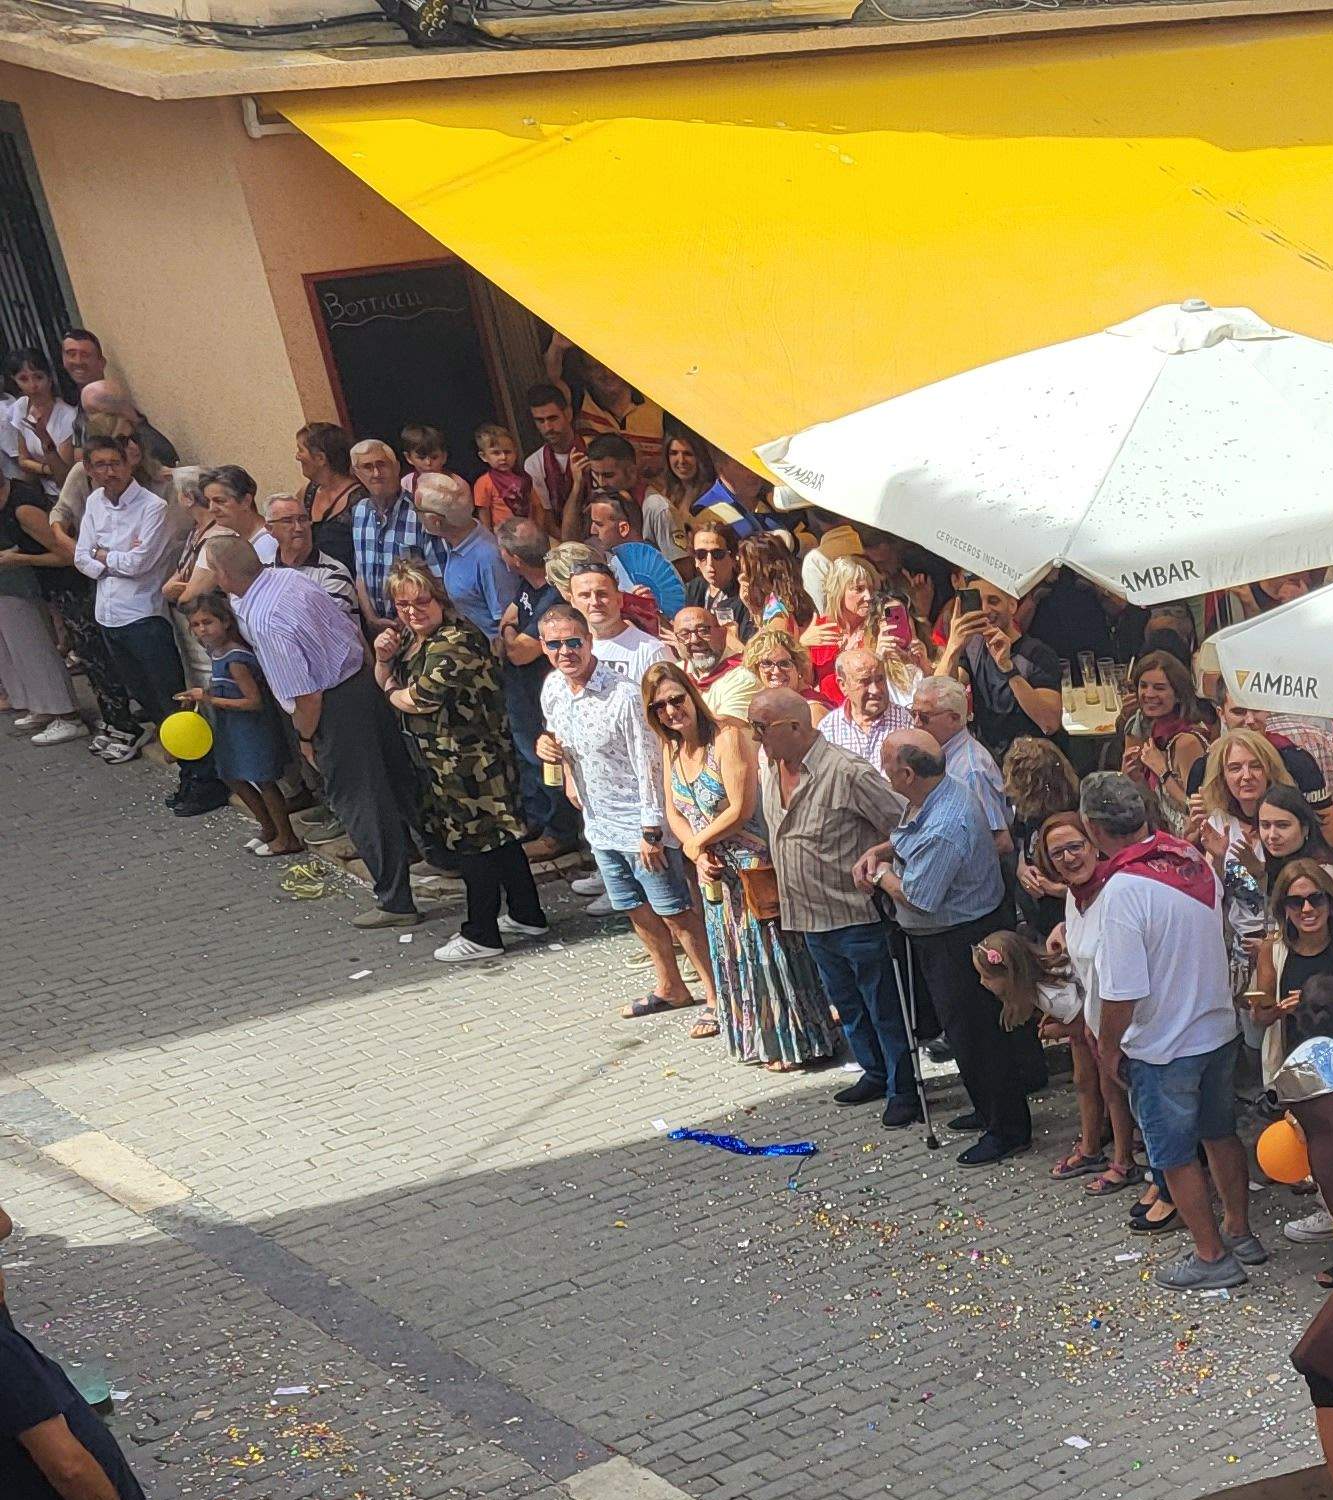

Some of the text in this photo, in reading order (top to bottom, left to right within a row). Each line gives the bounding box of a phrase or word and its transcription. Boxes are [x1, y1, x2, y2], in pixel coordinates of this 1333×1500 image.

[777, 461, 825, 491] AMBAR
[936, 529, 982, 560] CERVECEROS
[1249, 671, 1319, 700] AMBAR
